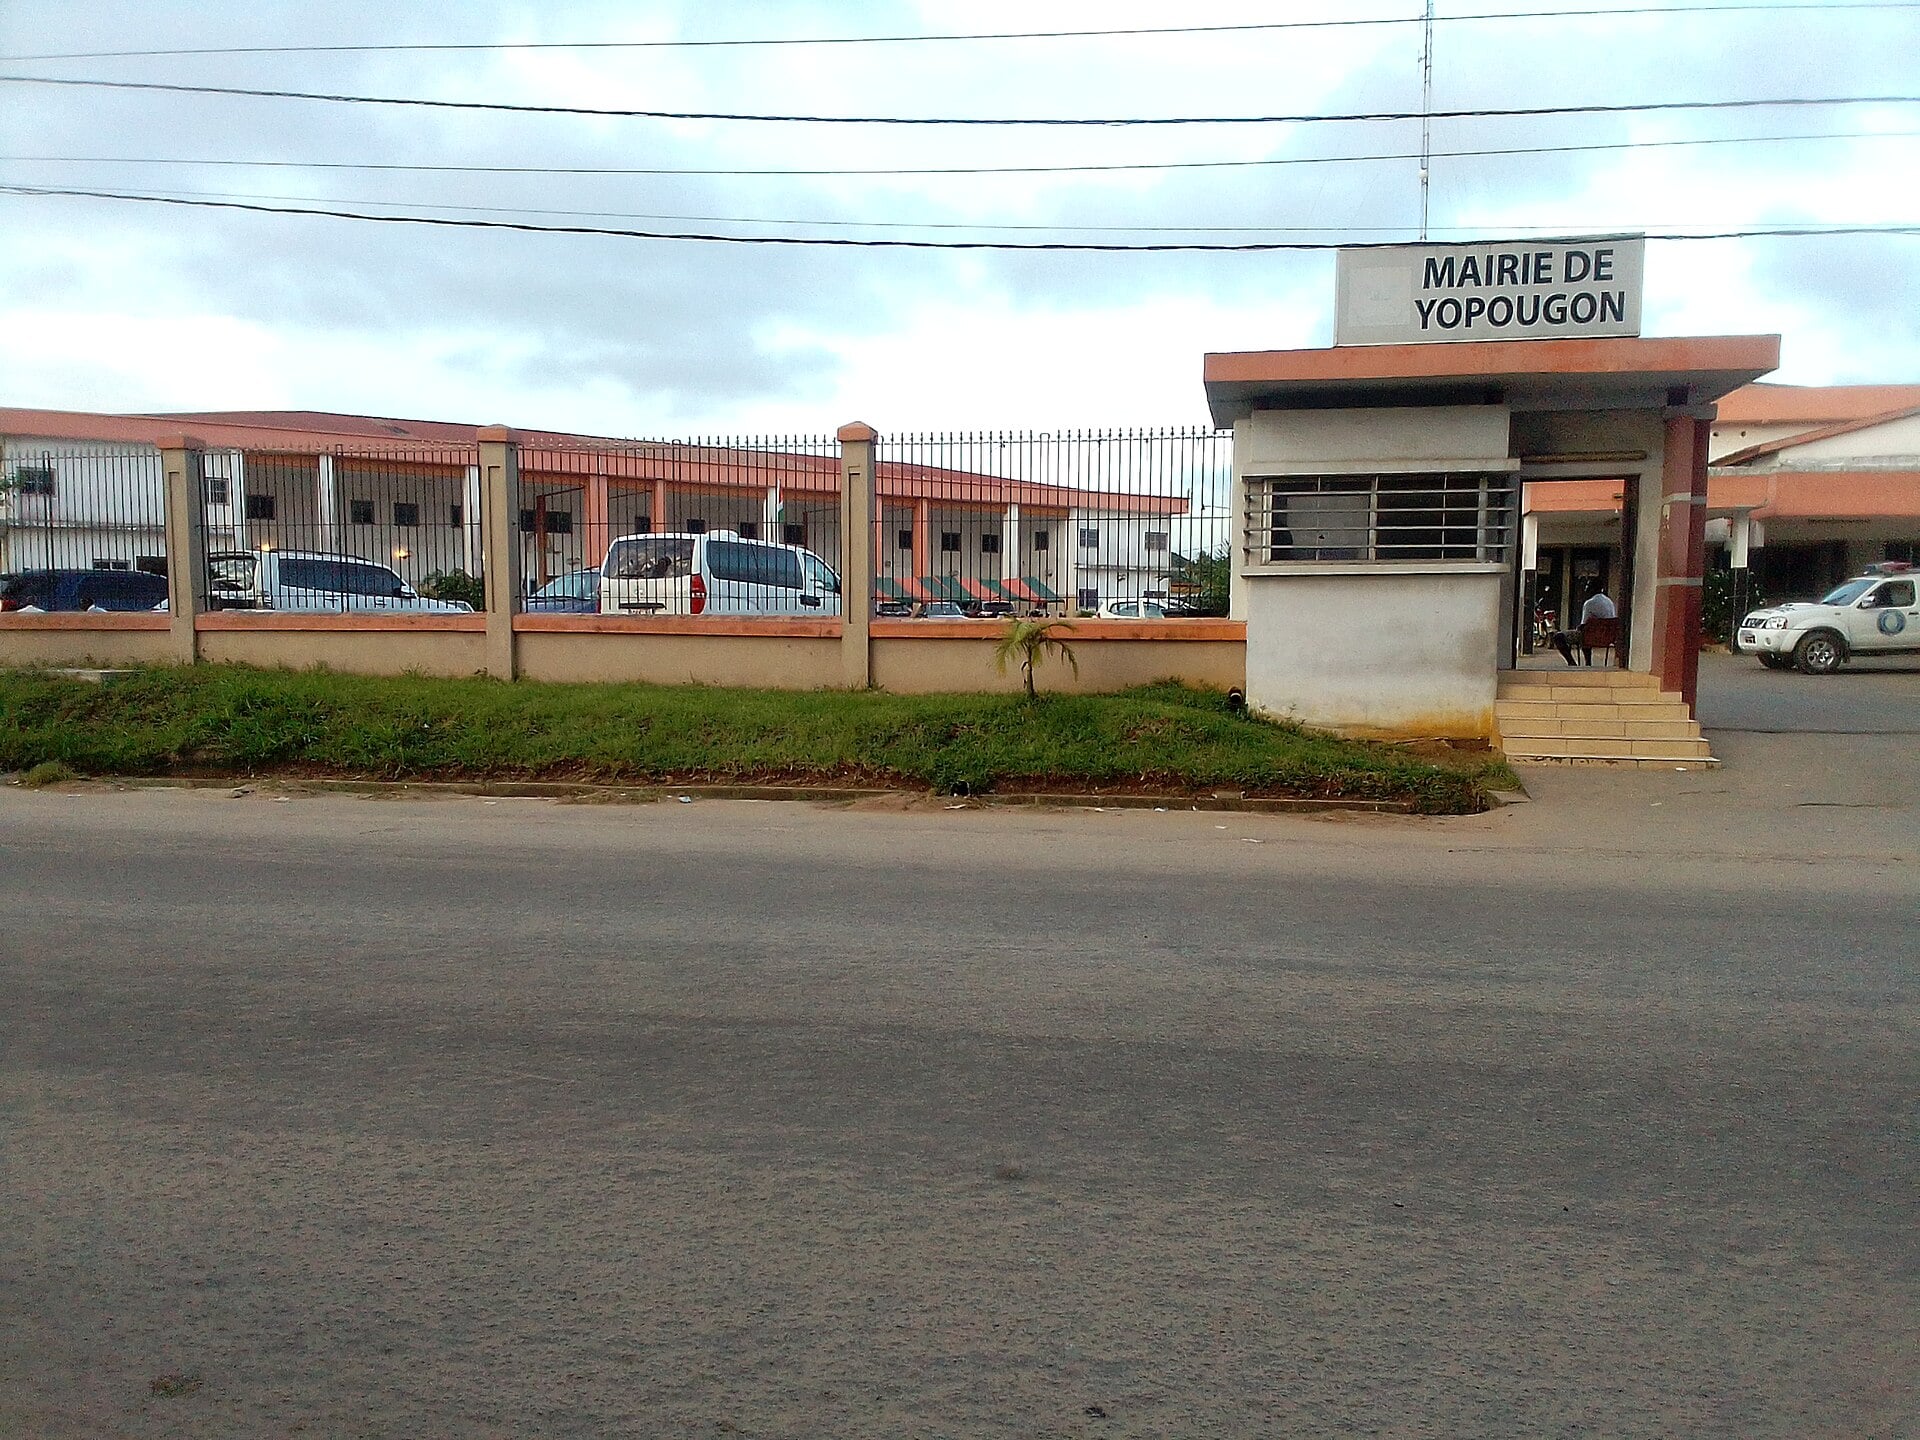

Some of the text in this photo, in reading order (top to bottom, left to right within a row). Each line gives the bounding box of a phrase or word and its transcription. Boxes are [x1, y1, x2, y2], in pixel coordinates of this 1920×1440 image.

[1422, 248, 1614, 290] MAIRIE DE
[1414, 290, 1625, 330] YOPOUGON
